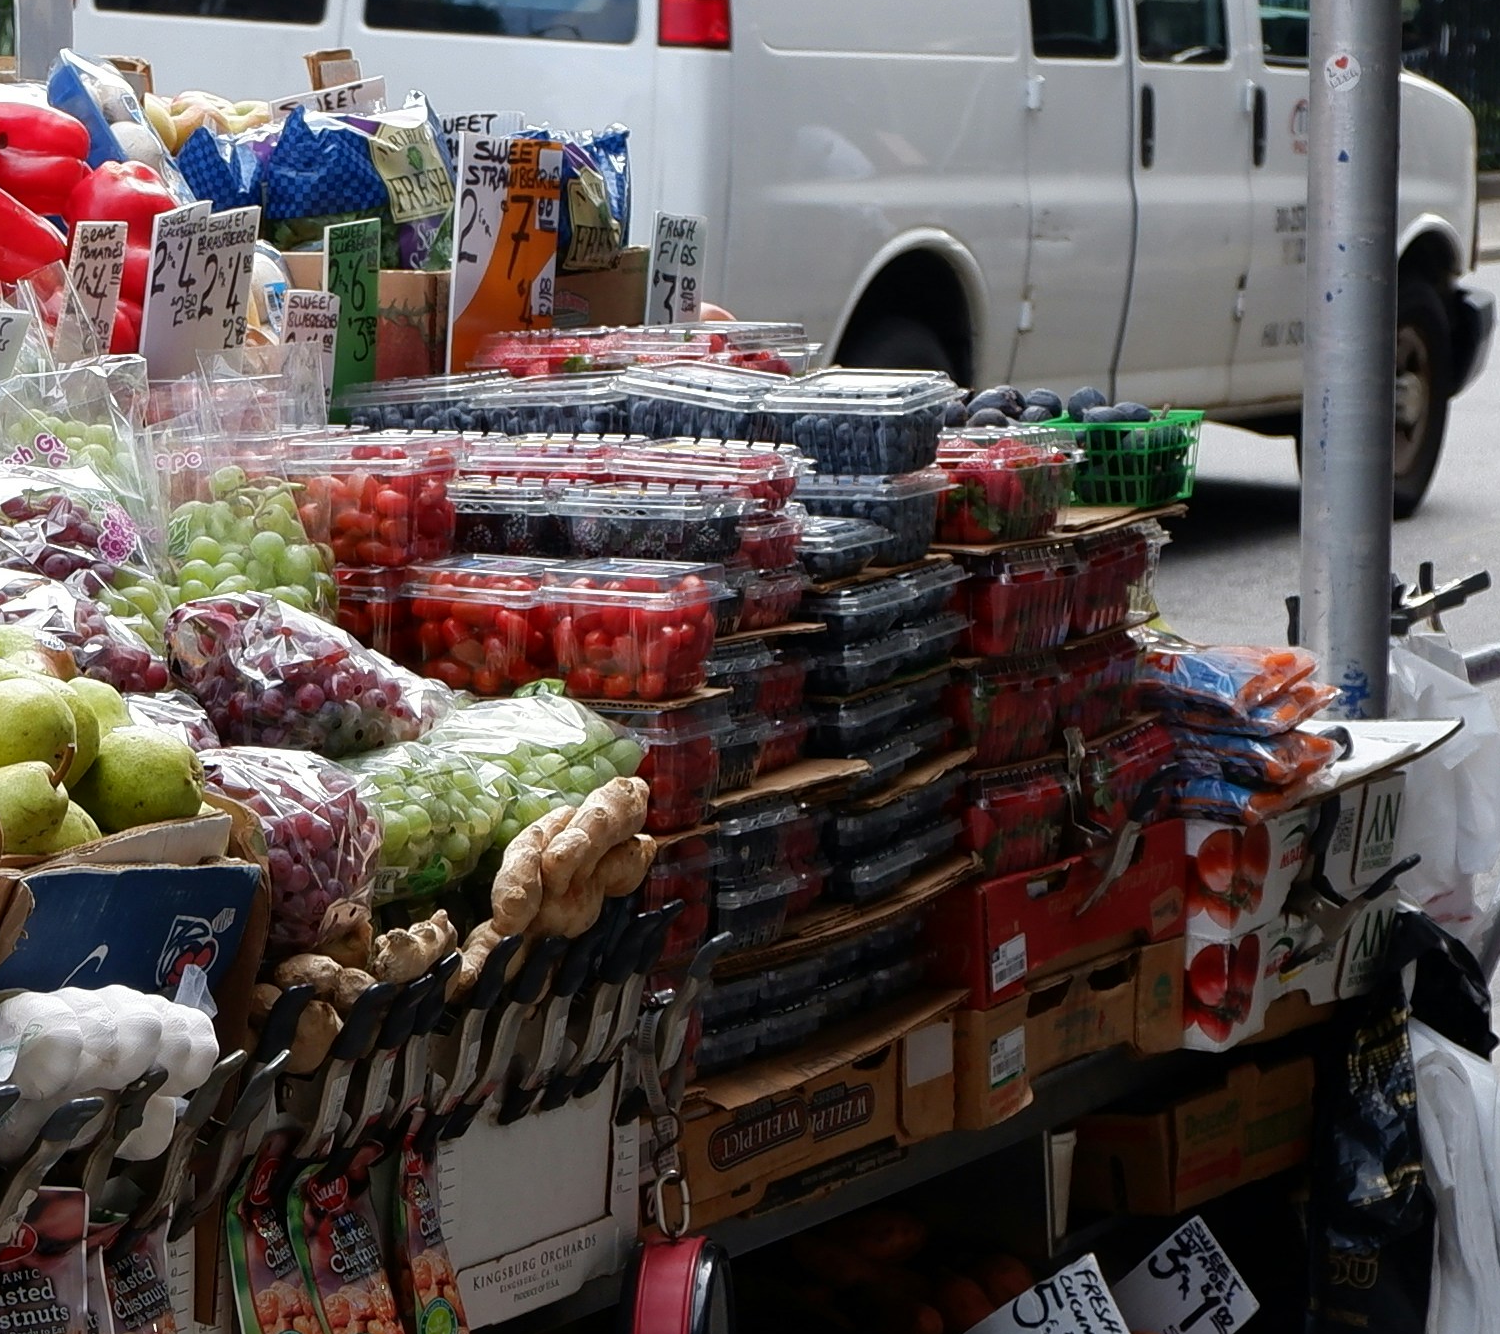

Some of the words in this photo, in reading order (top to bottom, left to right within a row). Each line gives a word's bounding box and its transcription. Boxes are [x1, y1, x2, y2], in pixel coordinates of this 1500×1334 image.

[389, 167, 454, 216] FRESH
[207, 214, 250, 234] SWEET
[659, 217, 698, 242] FRESH
[288, 294, 336, 312] SWEET
[472, 1257, 537, 1292] KINGSBURG
[540, 1233, 598, 1267] ORCHARDS
[1190, 1221, 1245, 1291] SWEET
[1073, 1267, 1122, 1334] FRESH
